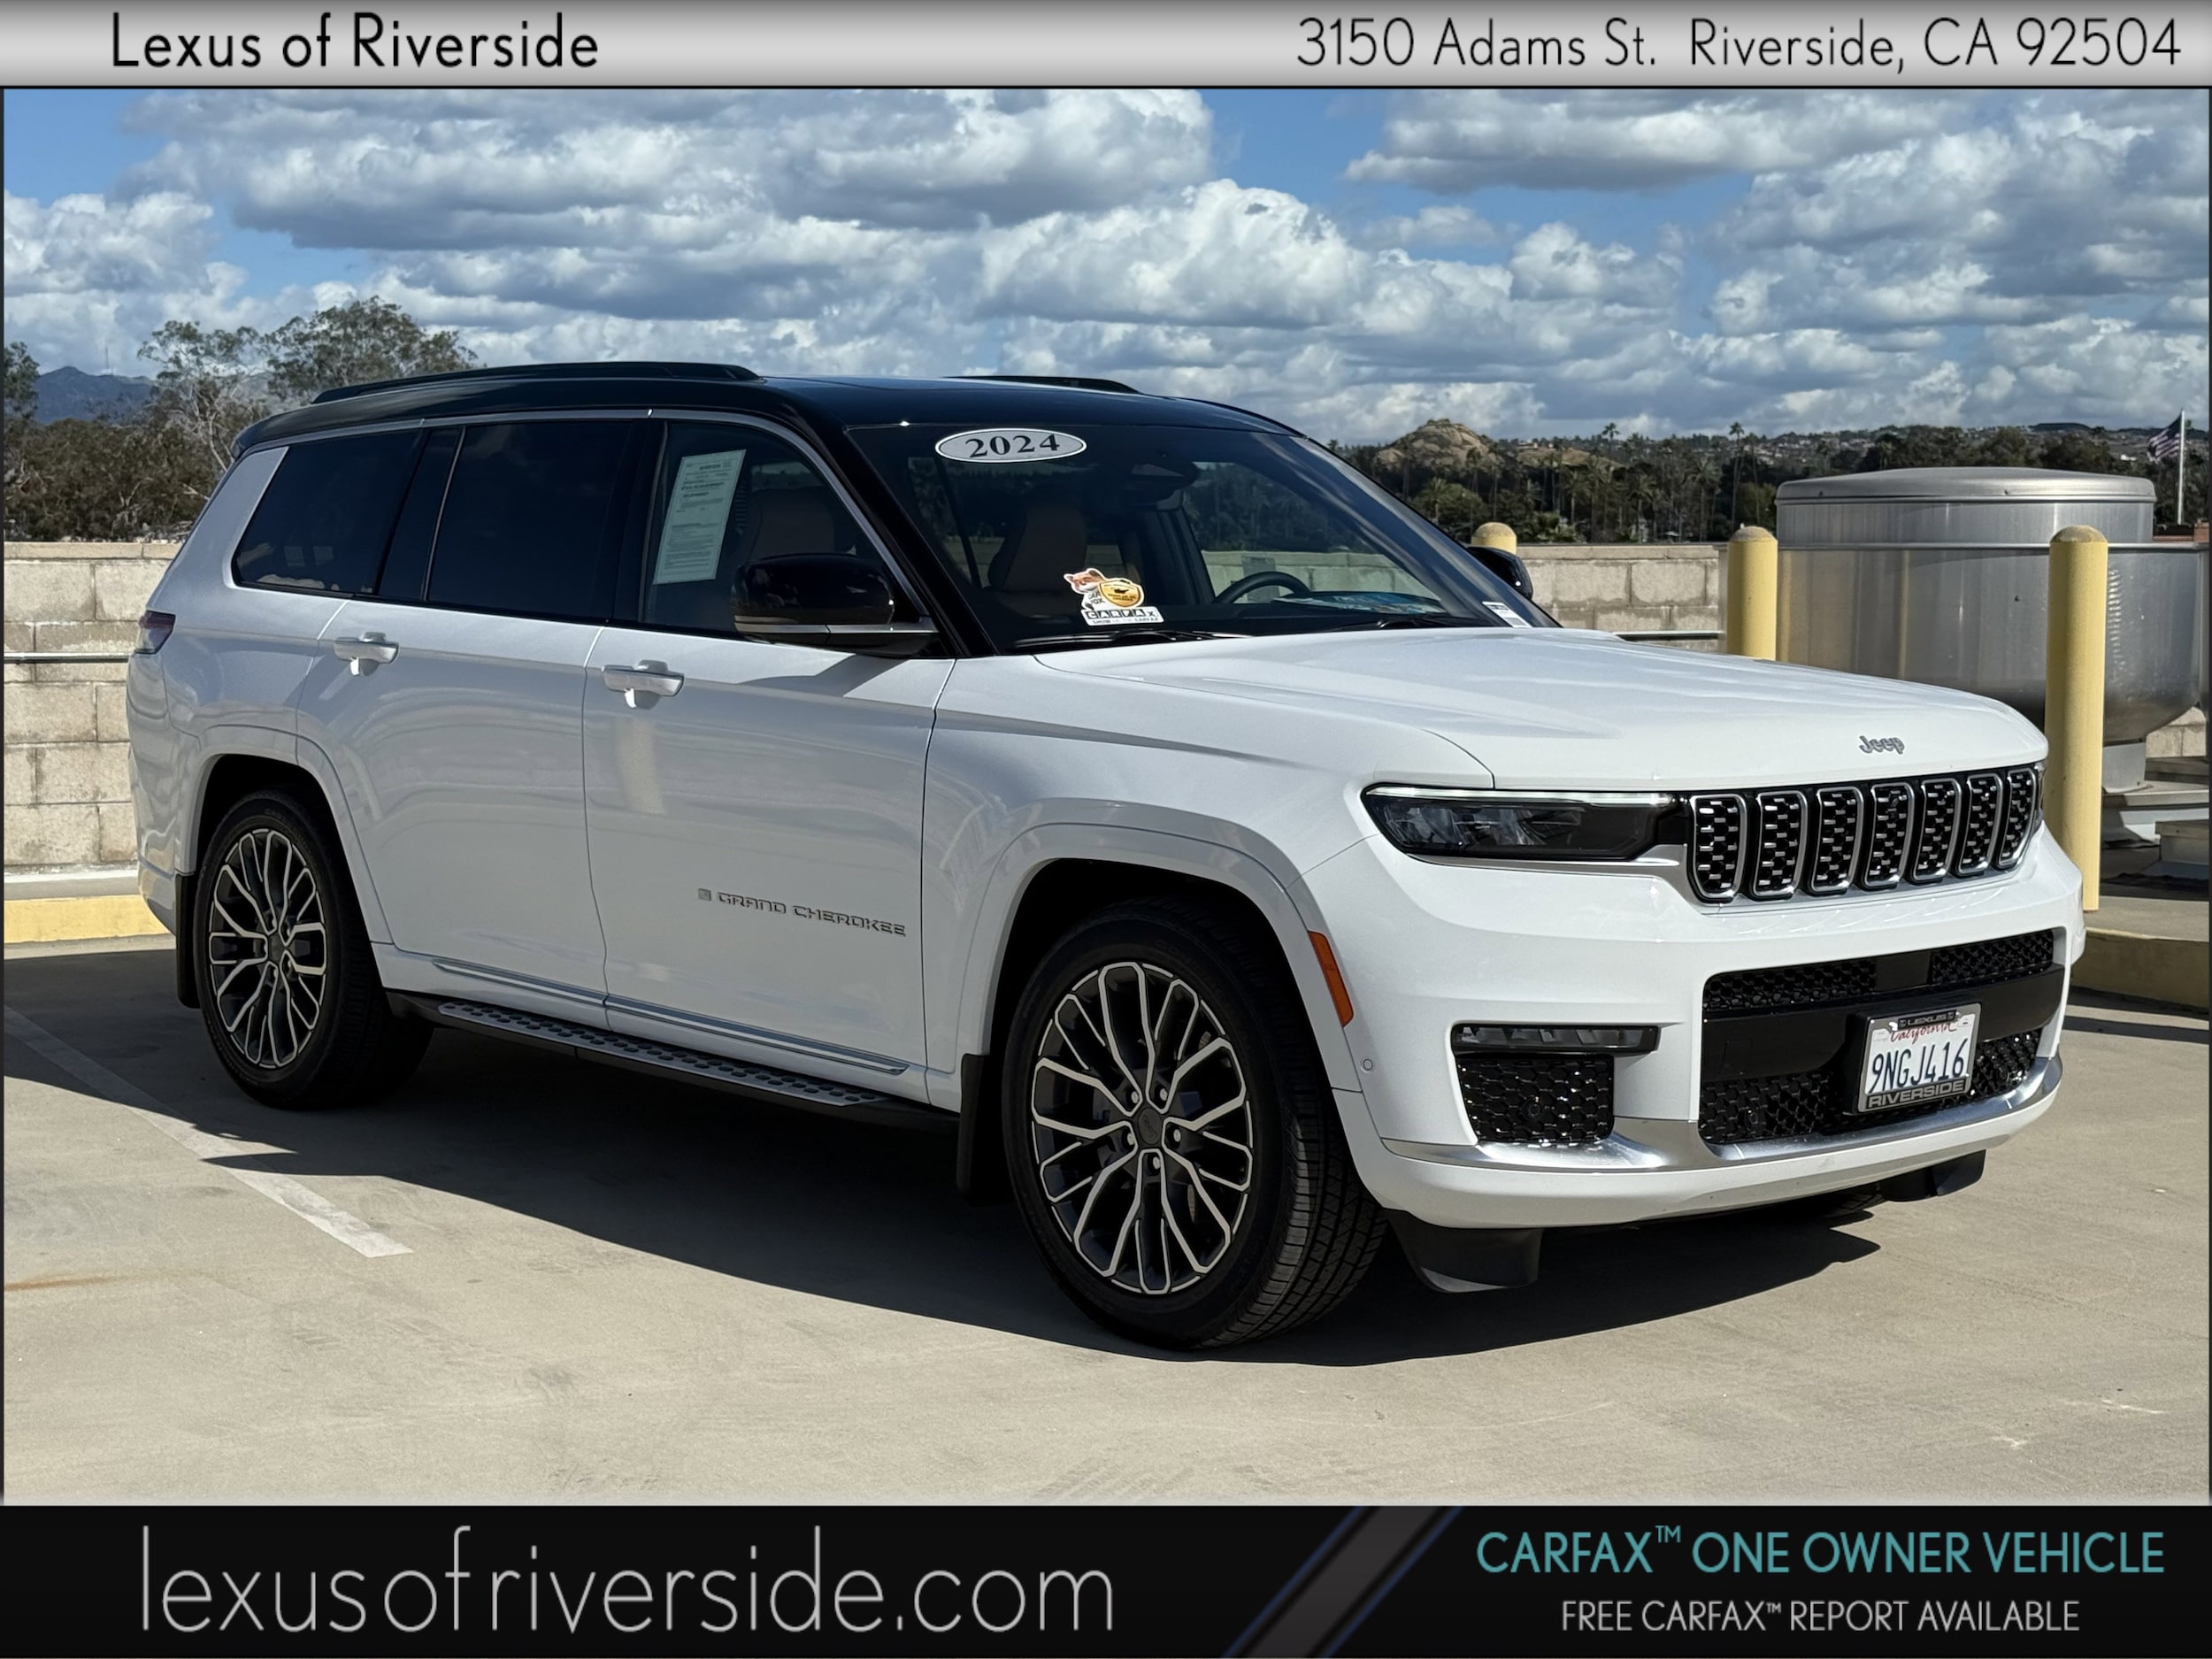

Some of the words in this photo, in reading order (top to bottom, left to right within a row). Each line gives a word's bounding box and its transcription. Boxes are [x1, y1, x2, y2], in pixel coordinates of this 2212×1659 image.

[965, 434, 1060, 458] 2024
[1085, 609, 1156, 619] CARFAX
[1859, 735, 1905, 755] Jeep
[718, 892, 787, 913] GRAND
[792, 905, 906, 937] CHEROKEE
[1907, 1014, 1947, 1025] LEXUS
[1869, 1038, 1968, 1094] 9NGJ416
[1869, 1079, 1964, 1108] RIVERSIDE
